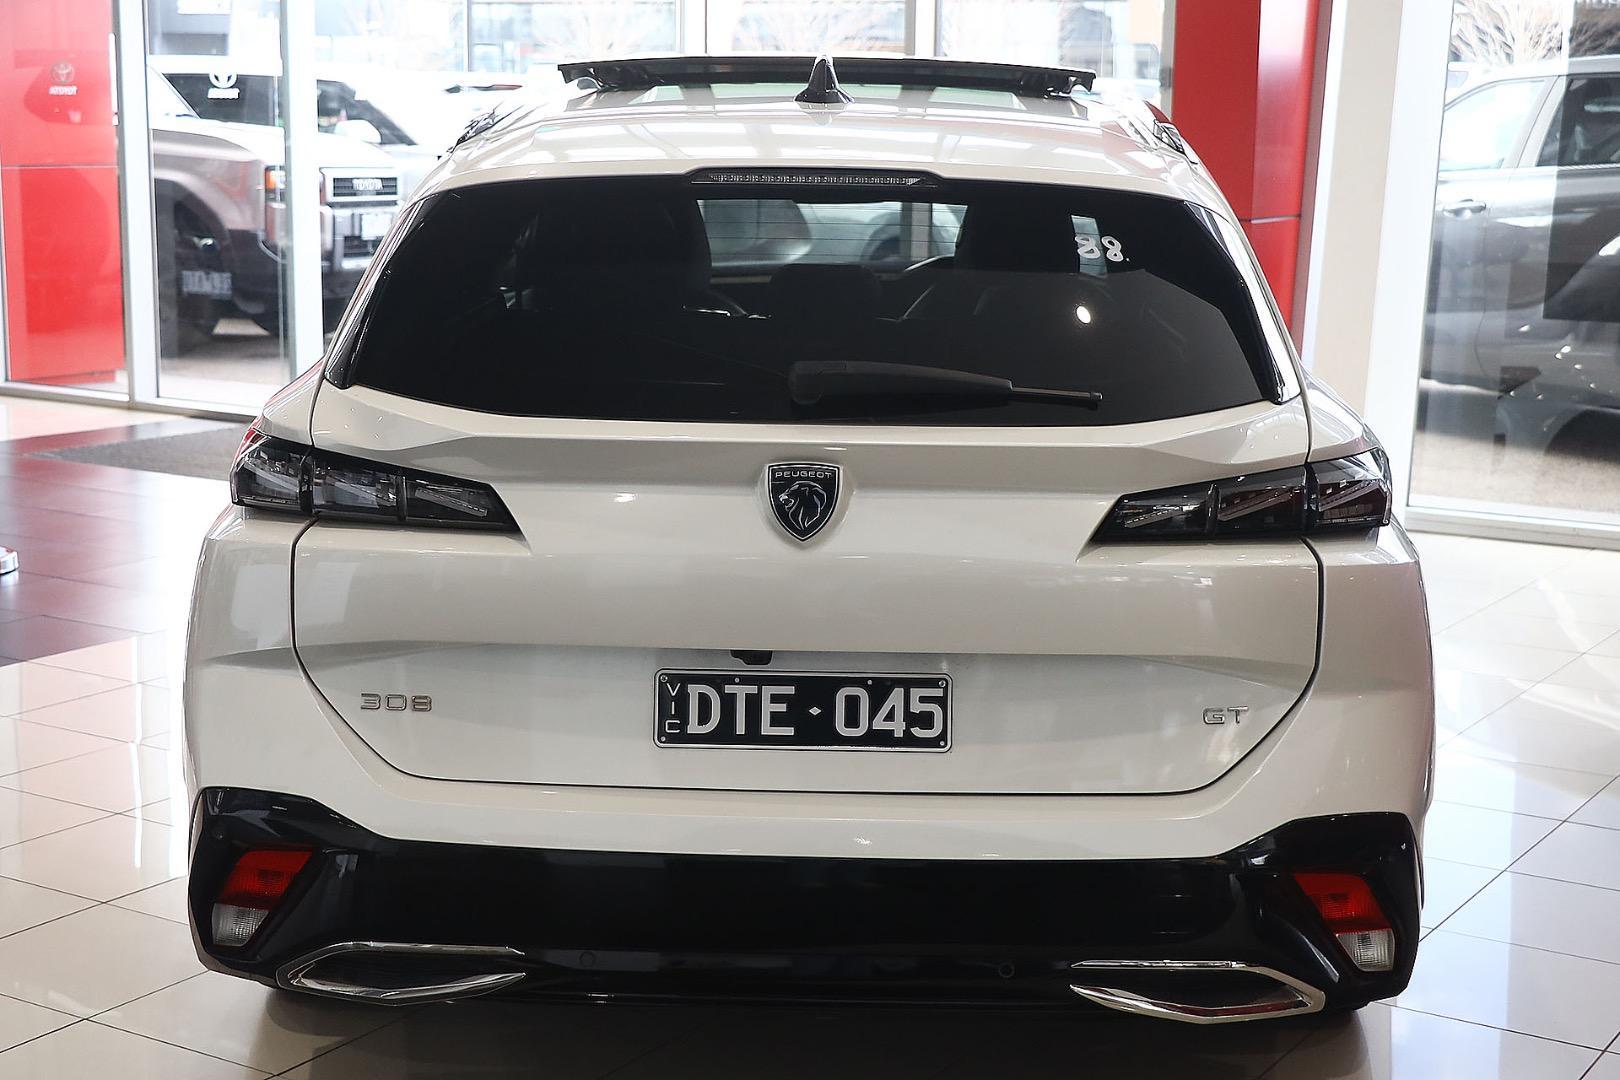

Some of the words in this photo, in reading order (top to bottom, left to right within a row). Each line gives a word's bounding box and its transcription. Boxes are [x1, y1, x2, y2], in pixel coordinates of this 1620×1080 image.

[361, 693, 432, 712] 308
[665, 683, 681, 733] VIC
[687, 684, 795, 735] DTE
[835, 687, 944, 737] 045
[1203, 706, 1248, 724] GT
